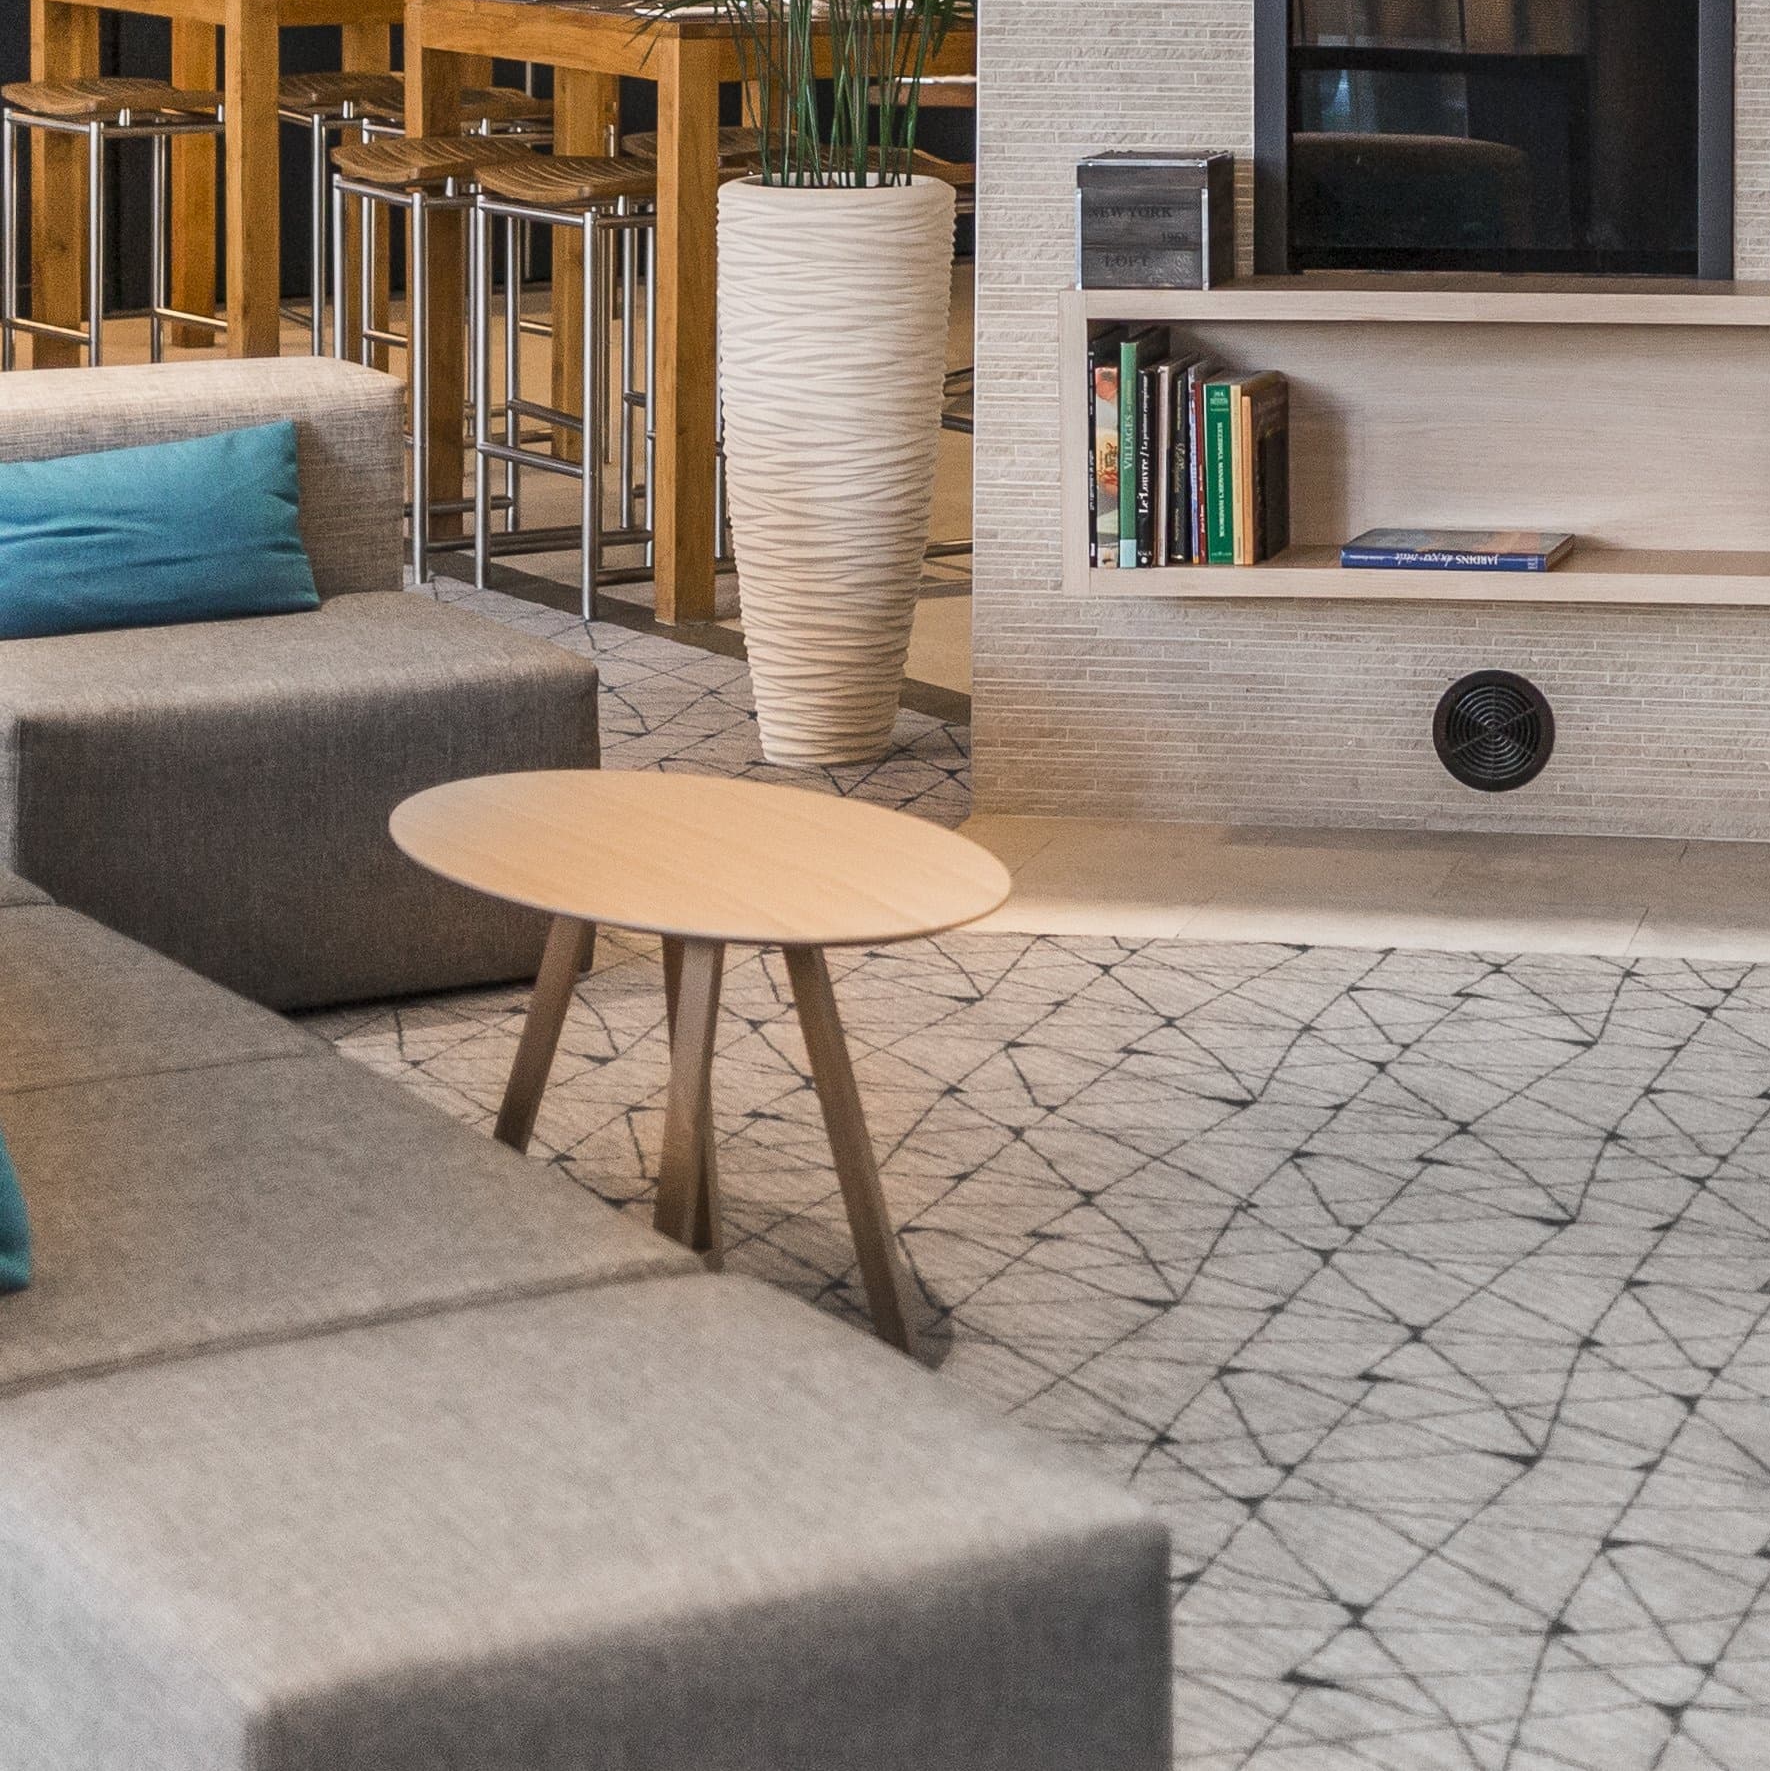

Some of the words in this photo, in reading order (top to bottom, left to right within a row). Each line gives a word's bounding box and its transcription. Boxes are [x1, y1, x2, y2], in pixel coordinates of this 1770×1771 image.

[1123, 414, 1133, 470] VILLAGES
[1138, 457, 1149, 499] Louvre
[1139, 499, 1149, 514] Le
[1455, 554, 1499, 566] JARDINS
